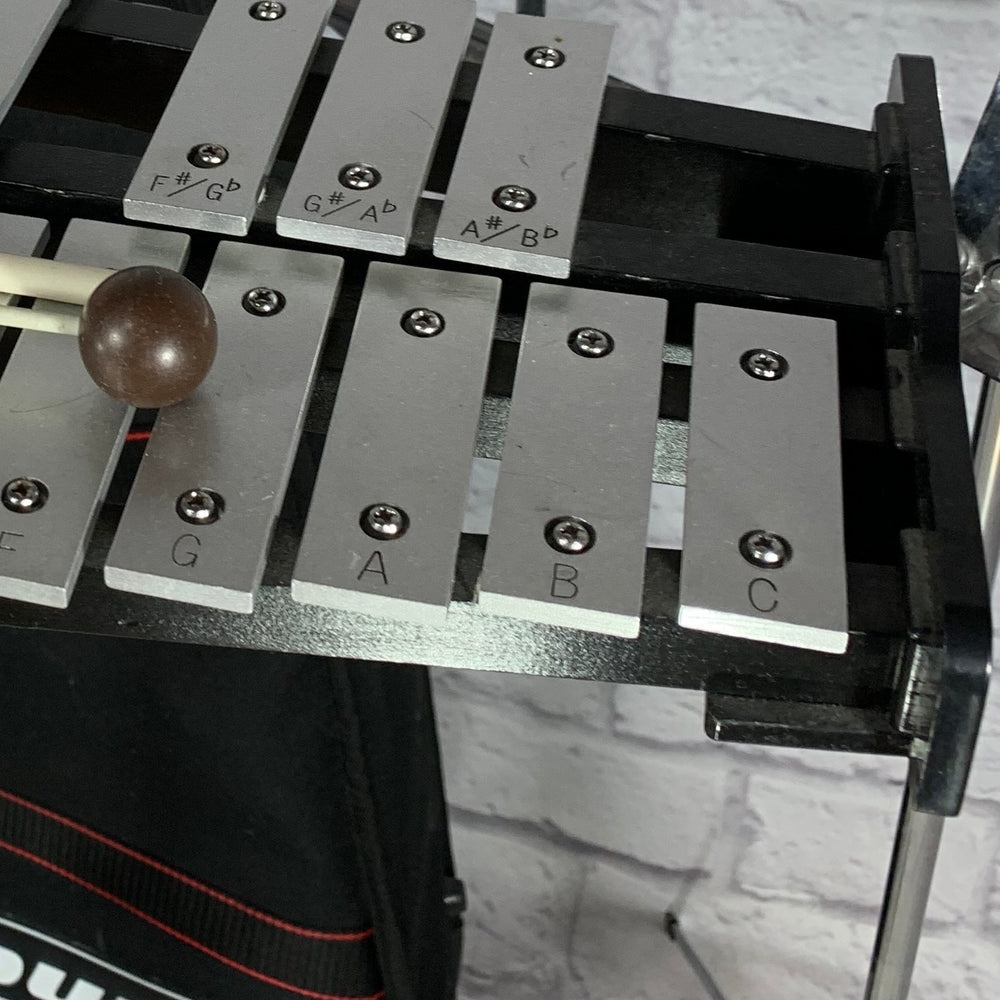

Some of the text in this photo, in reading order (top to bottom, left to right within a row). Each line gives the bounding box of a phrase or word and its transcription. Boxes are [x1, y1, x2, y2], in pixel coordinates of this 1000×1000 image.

[171, 533, 201, 568] G
[357, 550, 389, 586] A
[550, 562, 579, 599] B
[747, 577, 779, 613] C
